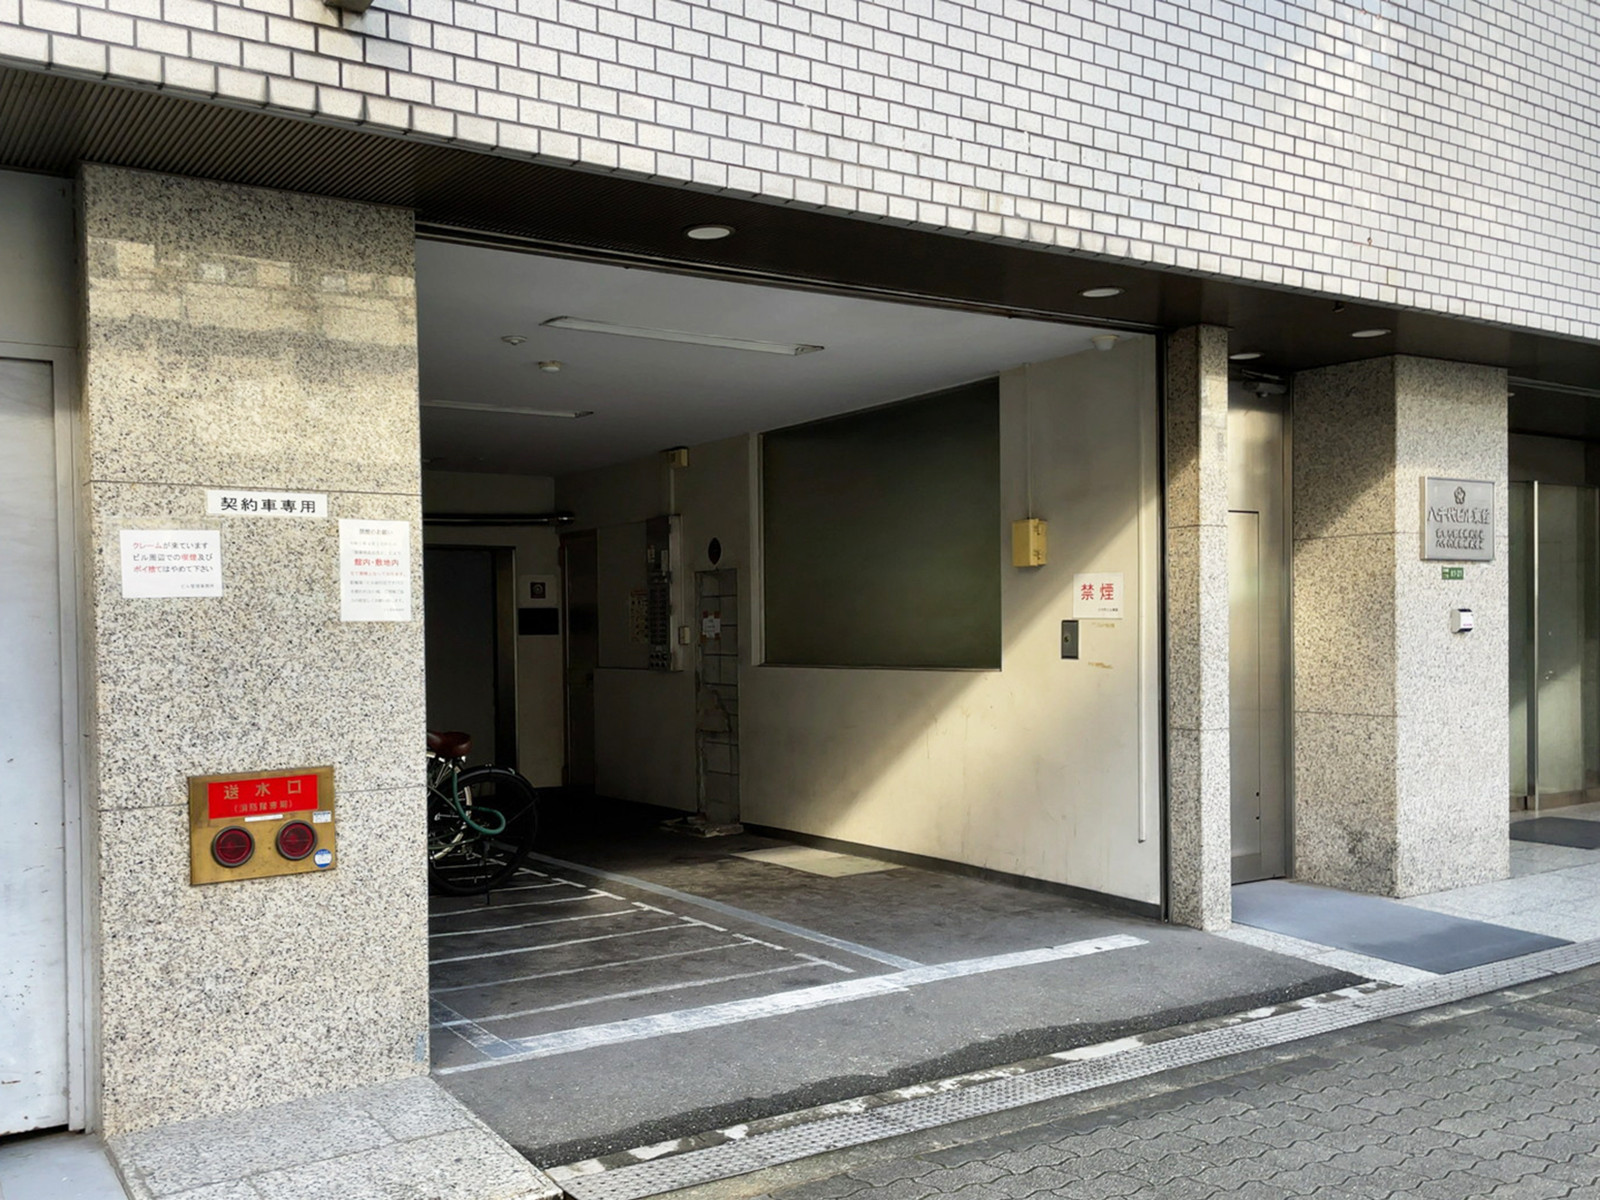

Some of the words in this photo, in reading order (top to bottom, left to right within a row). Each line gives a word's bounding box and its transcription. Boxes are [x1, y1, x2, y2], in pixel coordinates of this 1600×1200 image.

[220, 496, 316, 514] 契約車専用
[132, 541, 208, 550] クレームが来ています
[133, 553, 213, 562] ビル周辺での喫煙及び
[353, 557, 399, 567] 館内・敷地内
[133, 564, 213, 573] ポイ捨てはやめて下さい
[1080, 583, 1114, 601] 禁煙
[223, 779, 301, 800] 送水口
